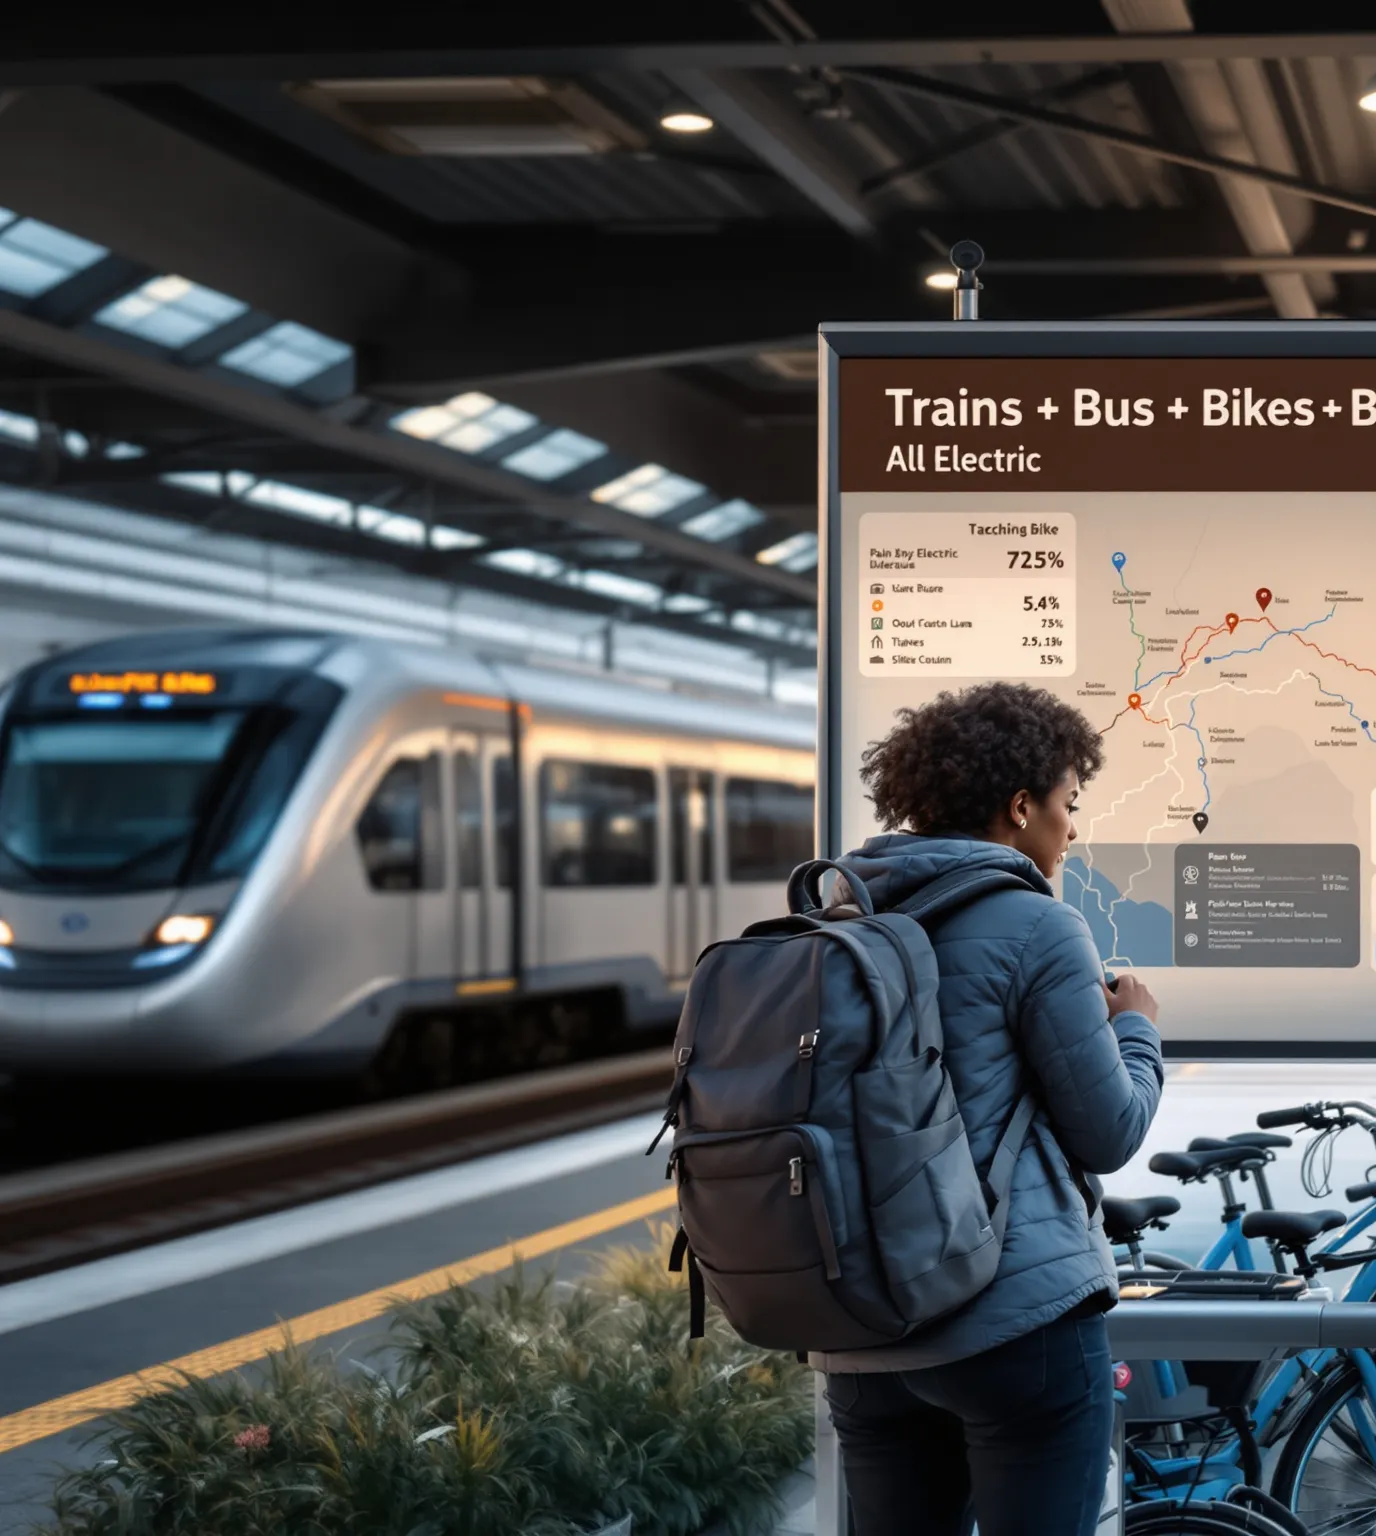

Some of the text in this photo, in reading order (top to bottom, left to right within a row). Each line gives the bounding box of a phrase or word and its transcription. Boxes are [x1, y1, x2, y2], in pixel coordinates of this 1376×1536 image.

[885, 388, 1022, 427] Trains
[1073, 388, 1155, 427] Bus
[1203, 388, 1314, 427] Bikes
[886, 445, 1042, 472] All Electric
[1007, 551, 1064, 569] 725%
